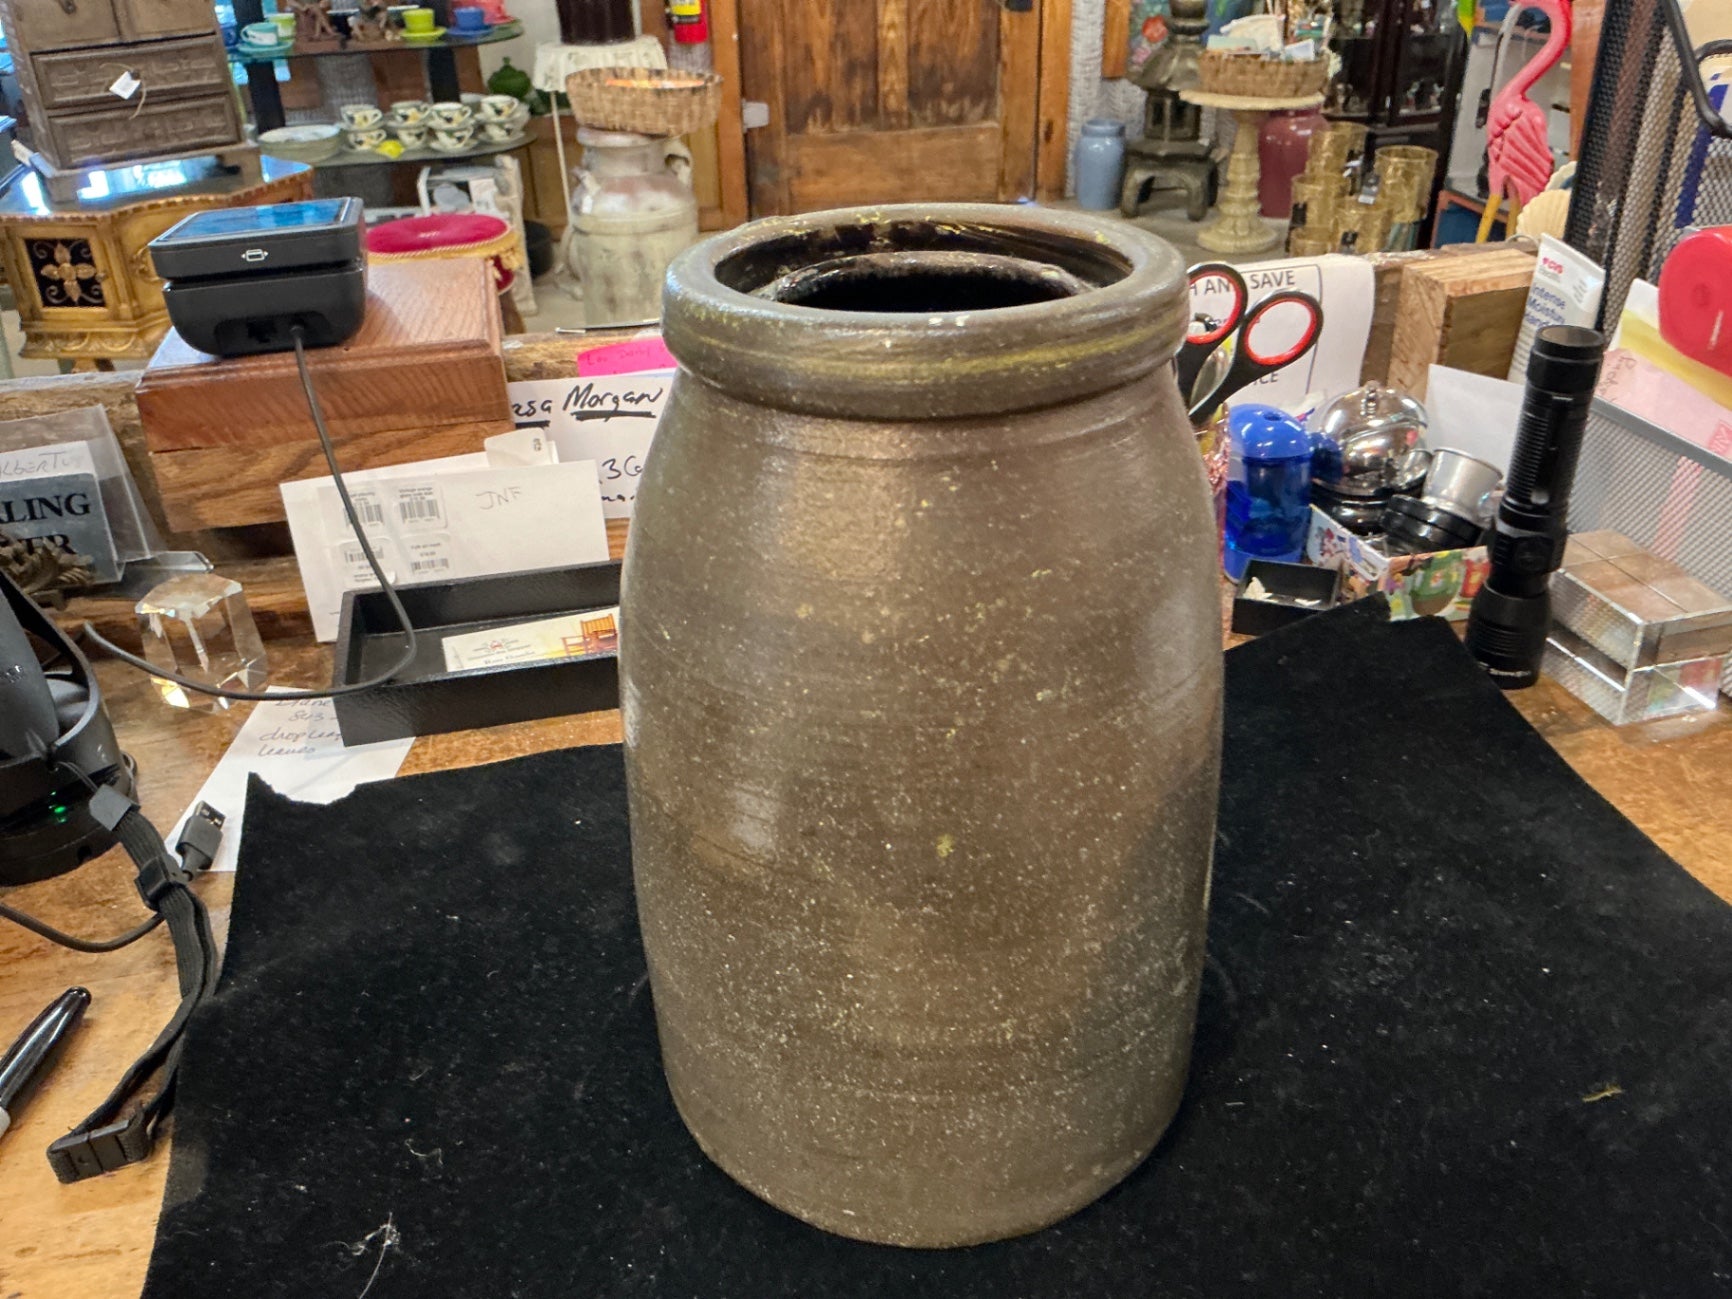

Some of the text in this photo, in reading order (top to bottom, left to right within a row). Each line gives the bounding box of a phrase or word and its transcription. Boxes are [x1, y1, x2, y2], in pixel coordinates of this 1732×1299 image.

[1249, 270, 1296, 290] SAVE
[562, 382, 664, 422] Morgan
[0, 492, 91, 524] LING
